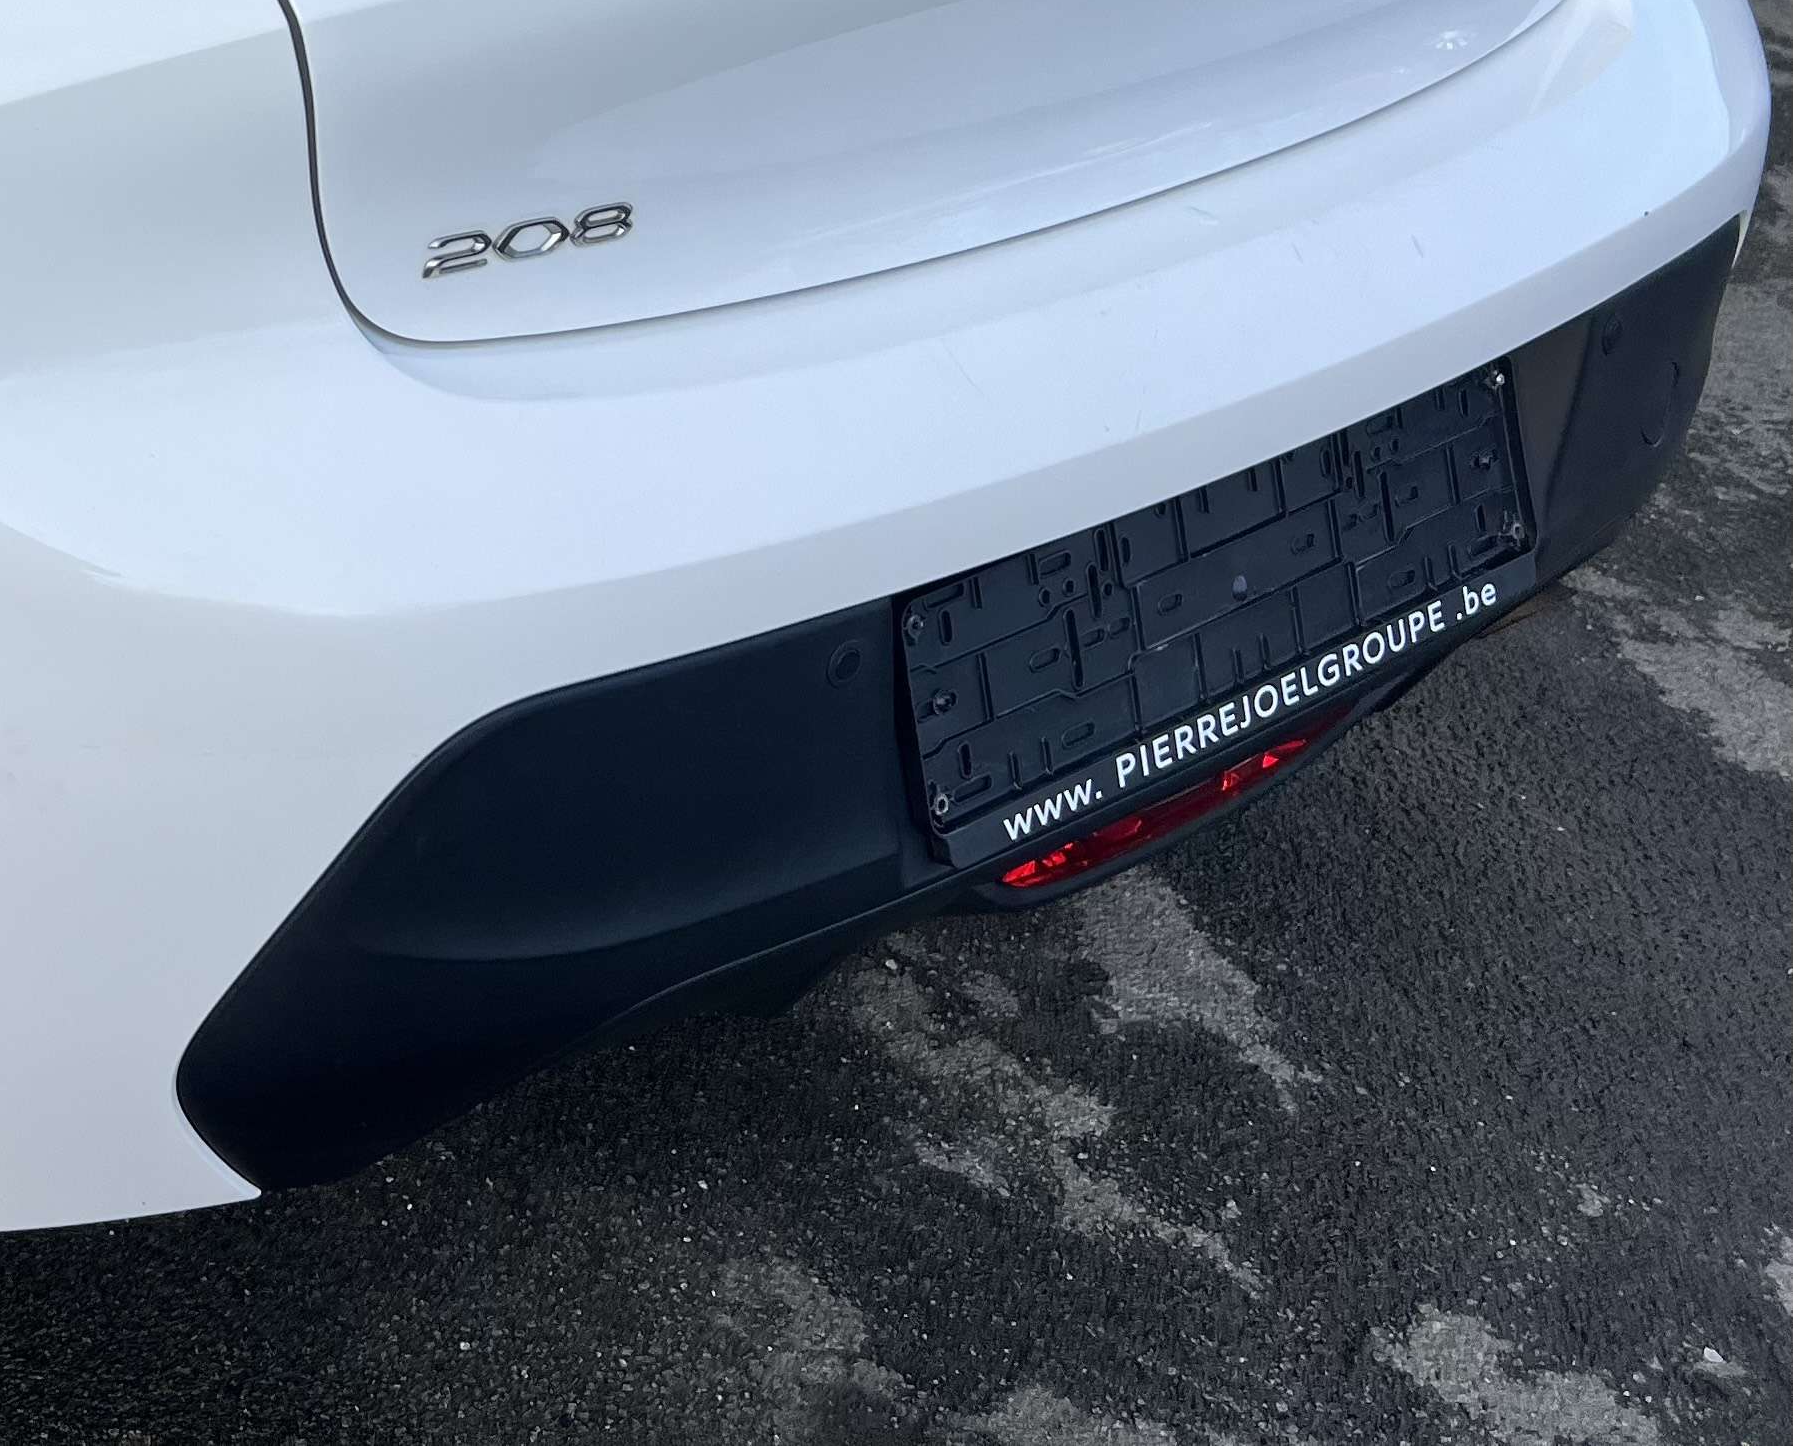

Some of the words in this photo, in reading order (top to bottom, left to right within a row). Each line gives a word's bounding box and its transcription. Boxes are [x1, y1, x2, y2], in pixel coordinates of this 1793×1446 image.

[422, 202, 634, 279] 208
[1003, 778, 1103, 841] www.
[1115, 599, 1446, 789] PIERREJOELGROUPE
